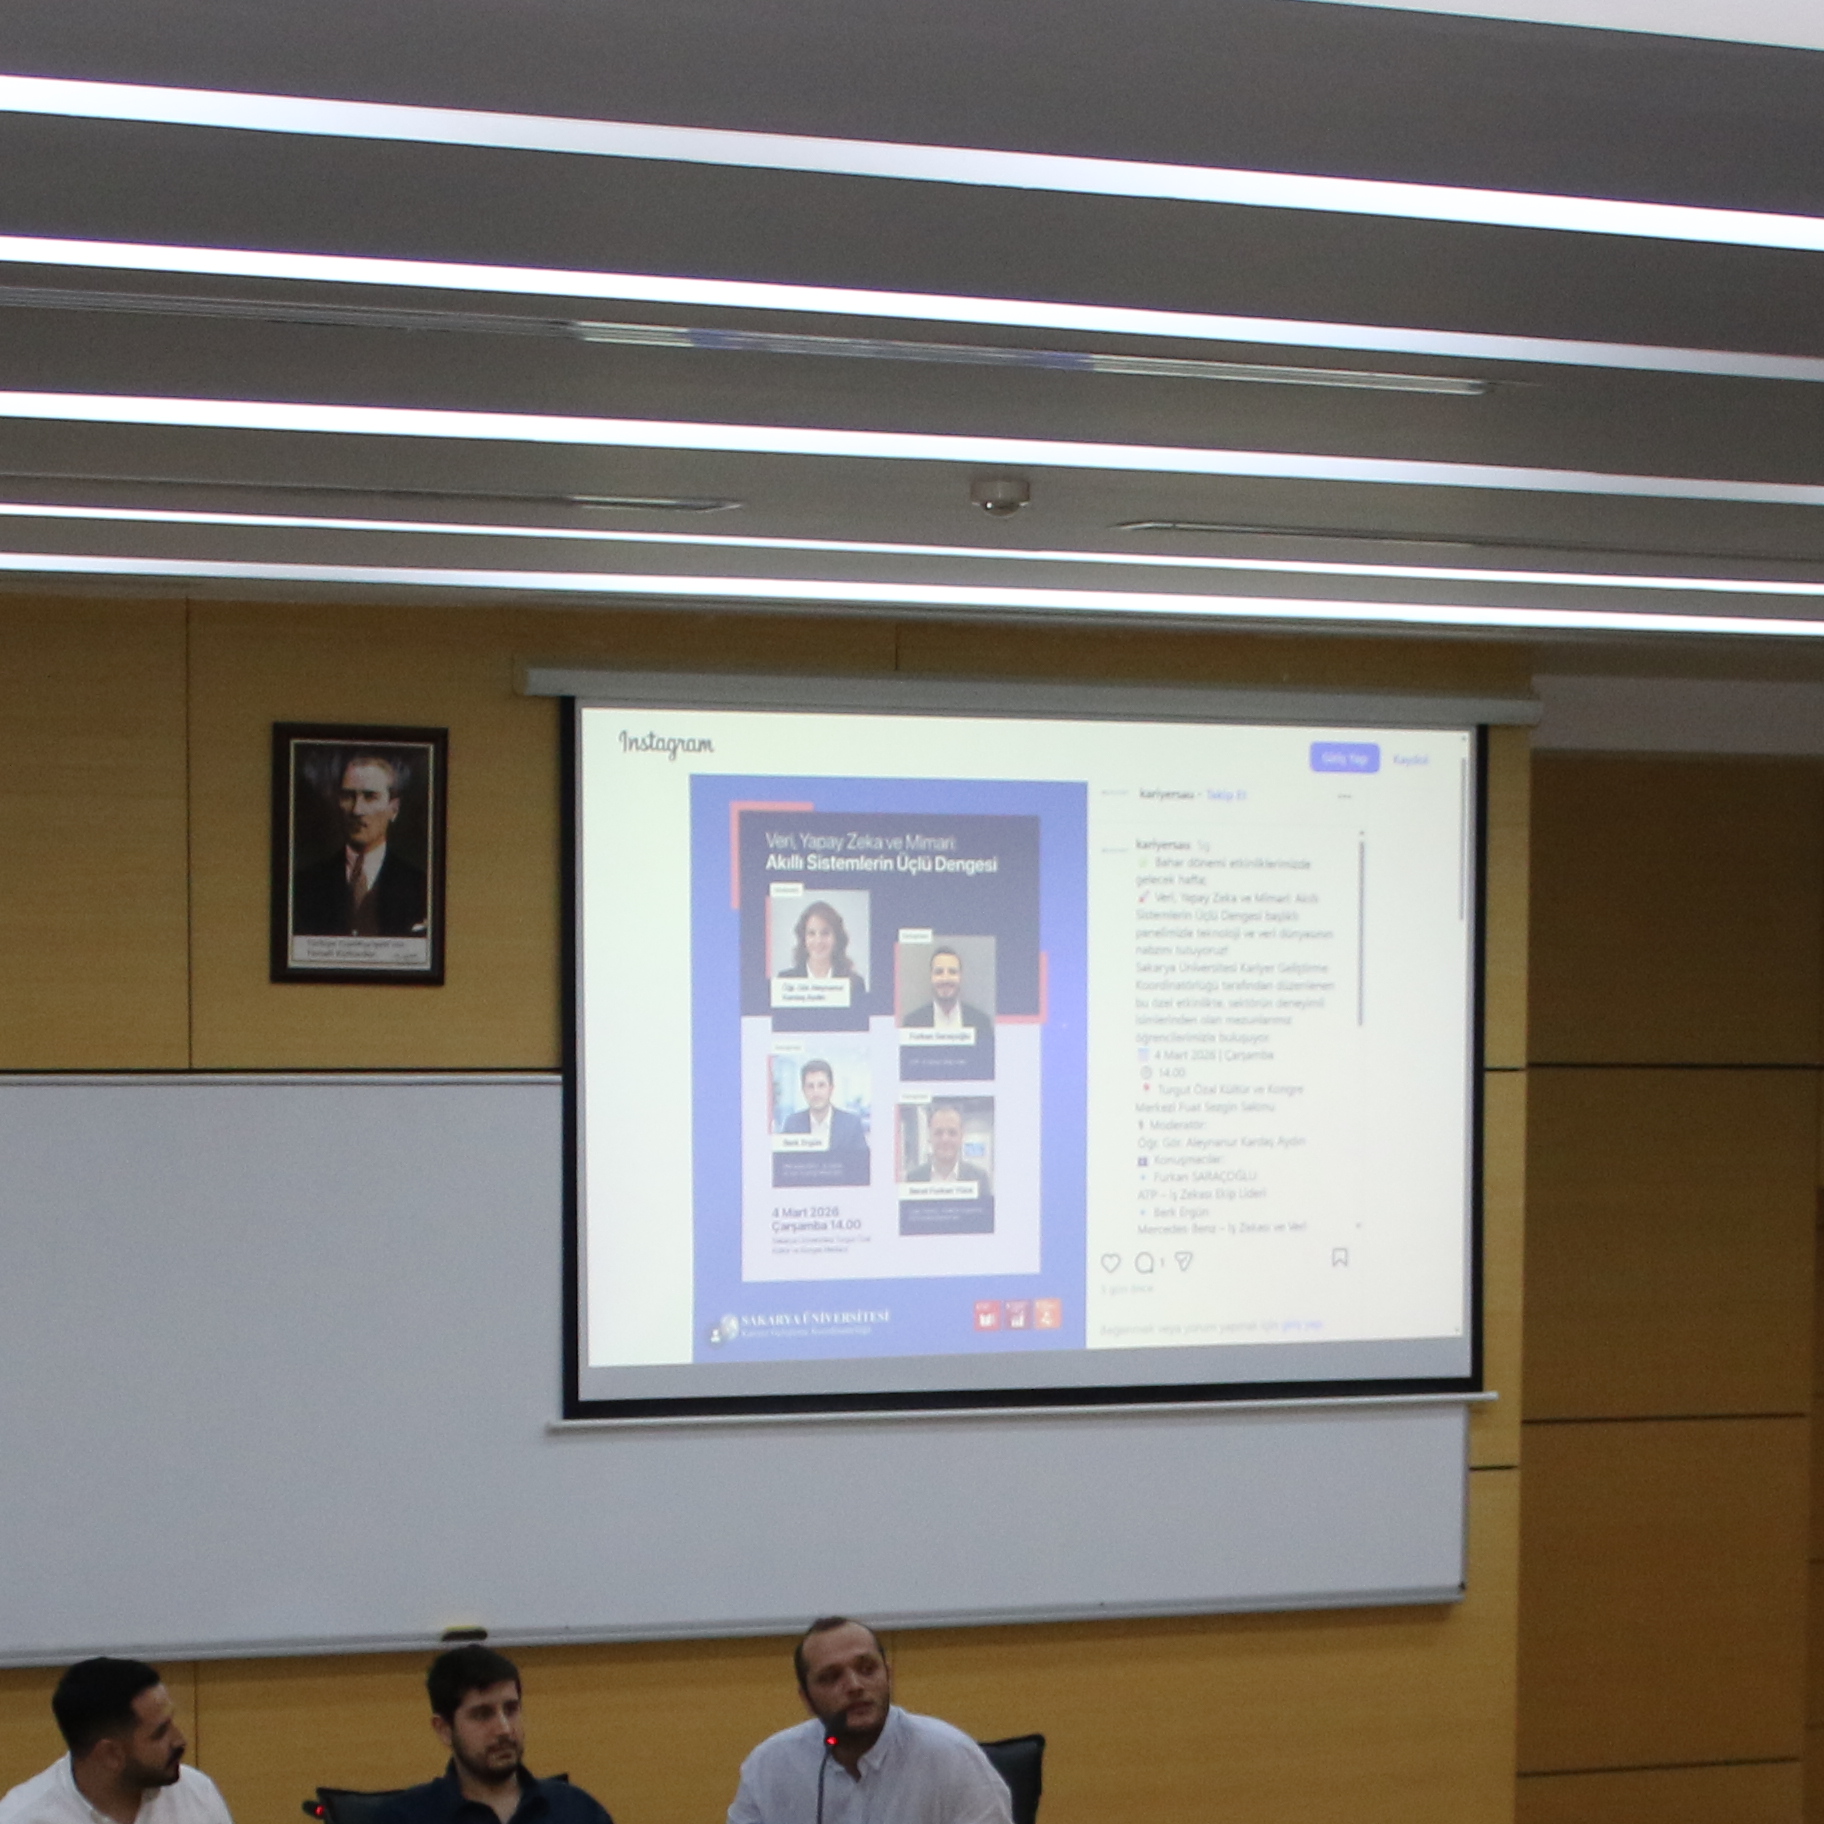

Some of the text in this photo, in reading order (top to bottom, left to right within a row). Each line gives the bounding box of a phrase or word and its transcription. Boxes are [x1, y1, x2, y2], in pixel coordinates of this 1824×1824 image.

[618, 729, 715, 763] Instagram
[800, 832, 845, 852] Yapay
[846, 832, 883, 850] Zeka
[885, 837, 903, 850] ve
[765, 852, 999, 876] Akıllı Sistemlerin Üçlü Dengesi
[1164, 1049, 1188, 1061] Mart
[771, 1205, 840, 1218] 4 Mart 2026
[771, 1218, 862, 1235] Çarşamba 14.00
[741, 1307, 891, 1327] SAKARYA ÜNİVERSİTESİ
